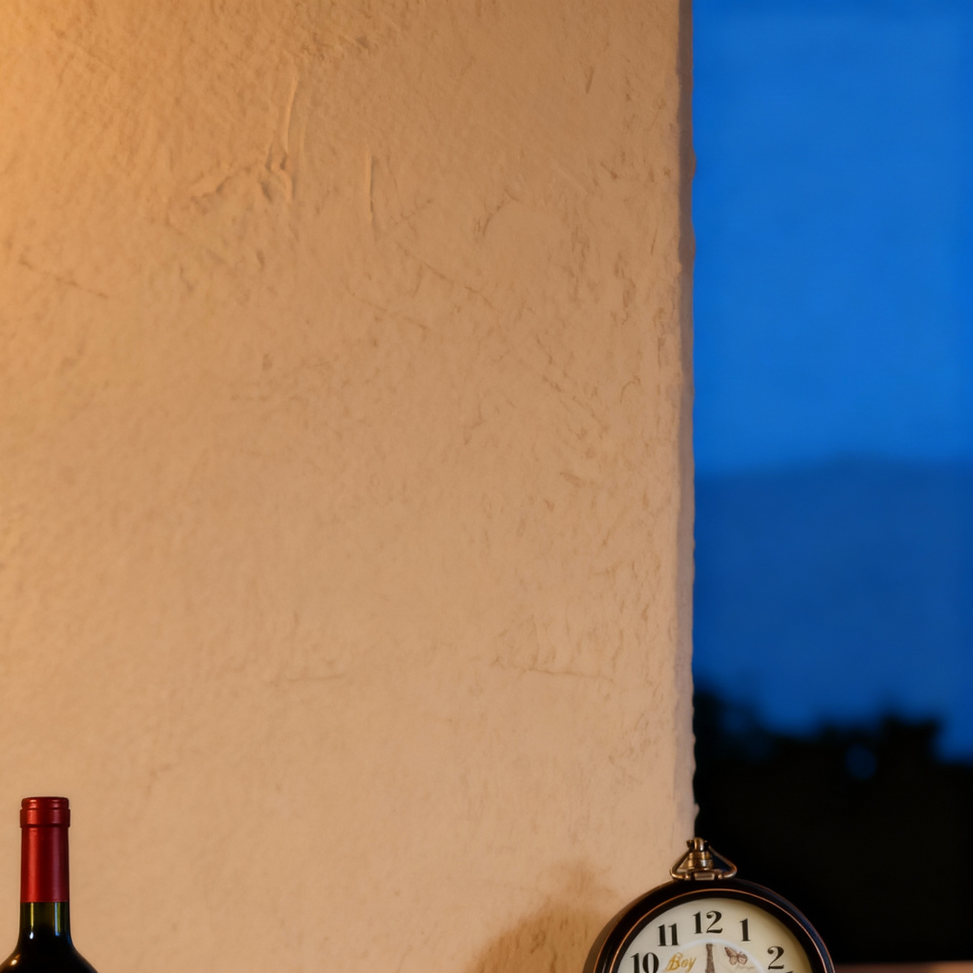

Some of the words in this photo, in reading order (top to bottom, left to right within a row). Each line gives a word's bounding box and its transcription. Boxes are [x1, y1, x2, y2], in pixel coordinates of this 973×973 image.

[693, 910, 723, 934] 12
[739, 918, 751, 942] 1
[657, 923, 679, 946] 11
[767, 946, 784, 970] 2
